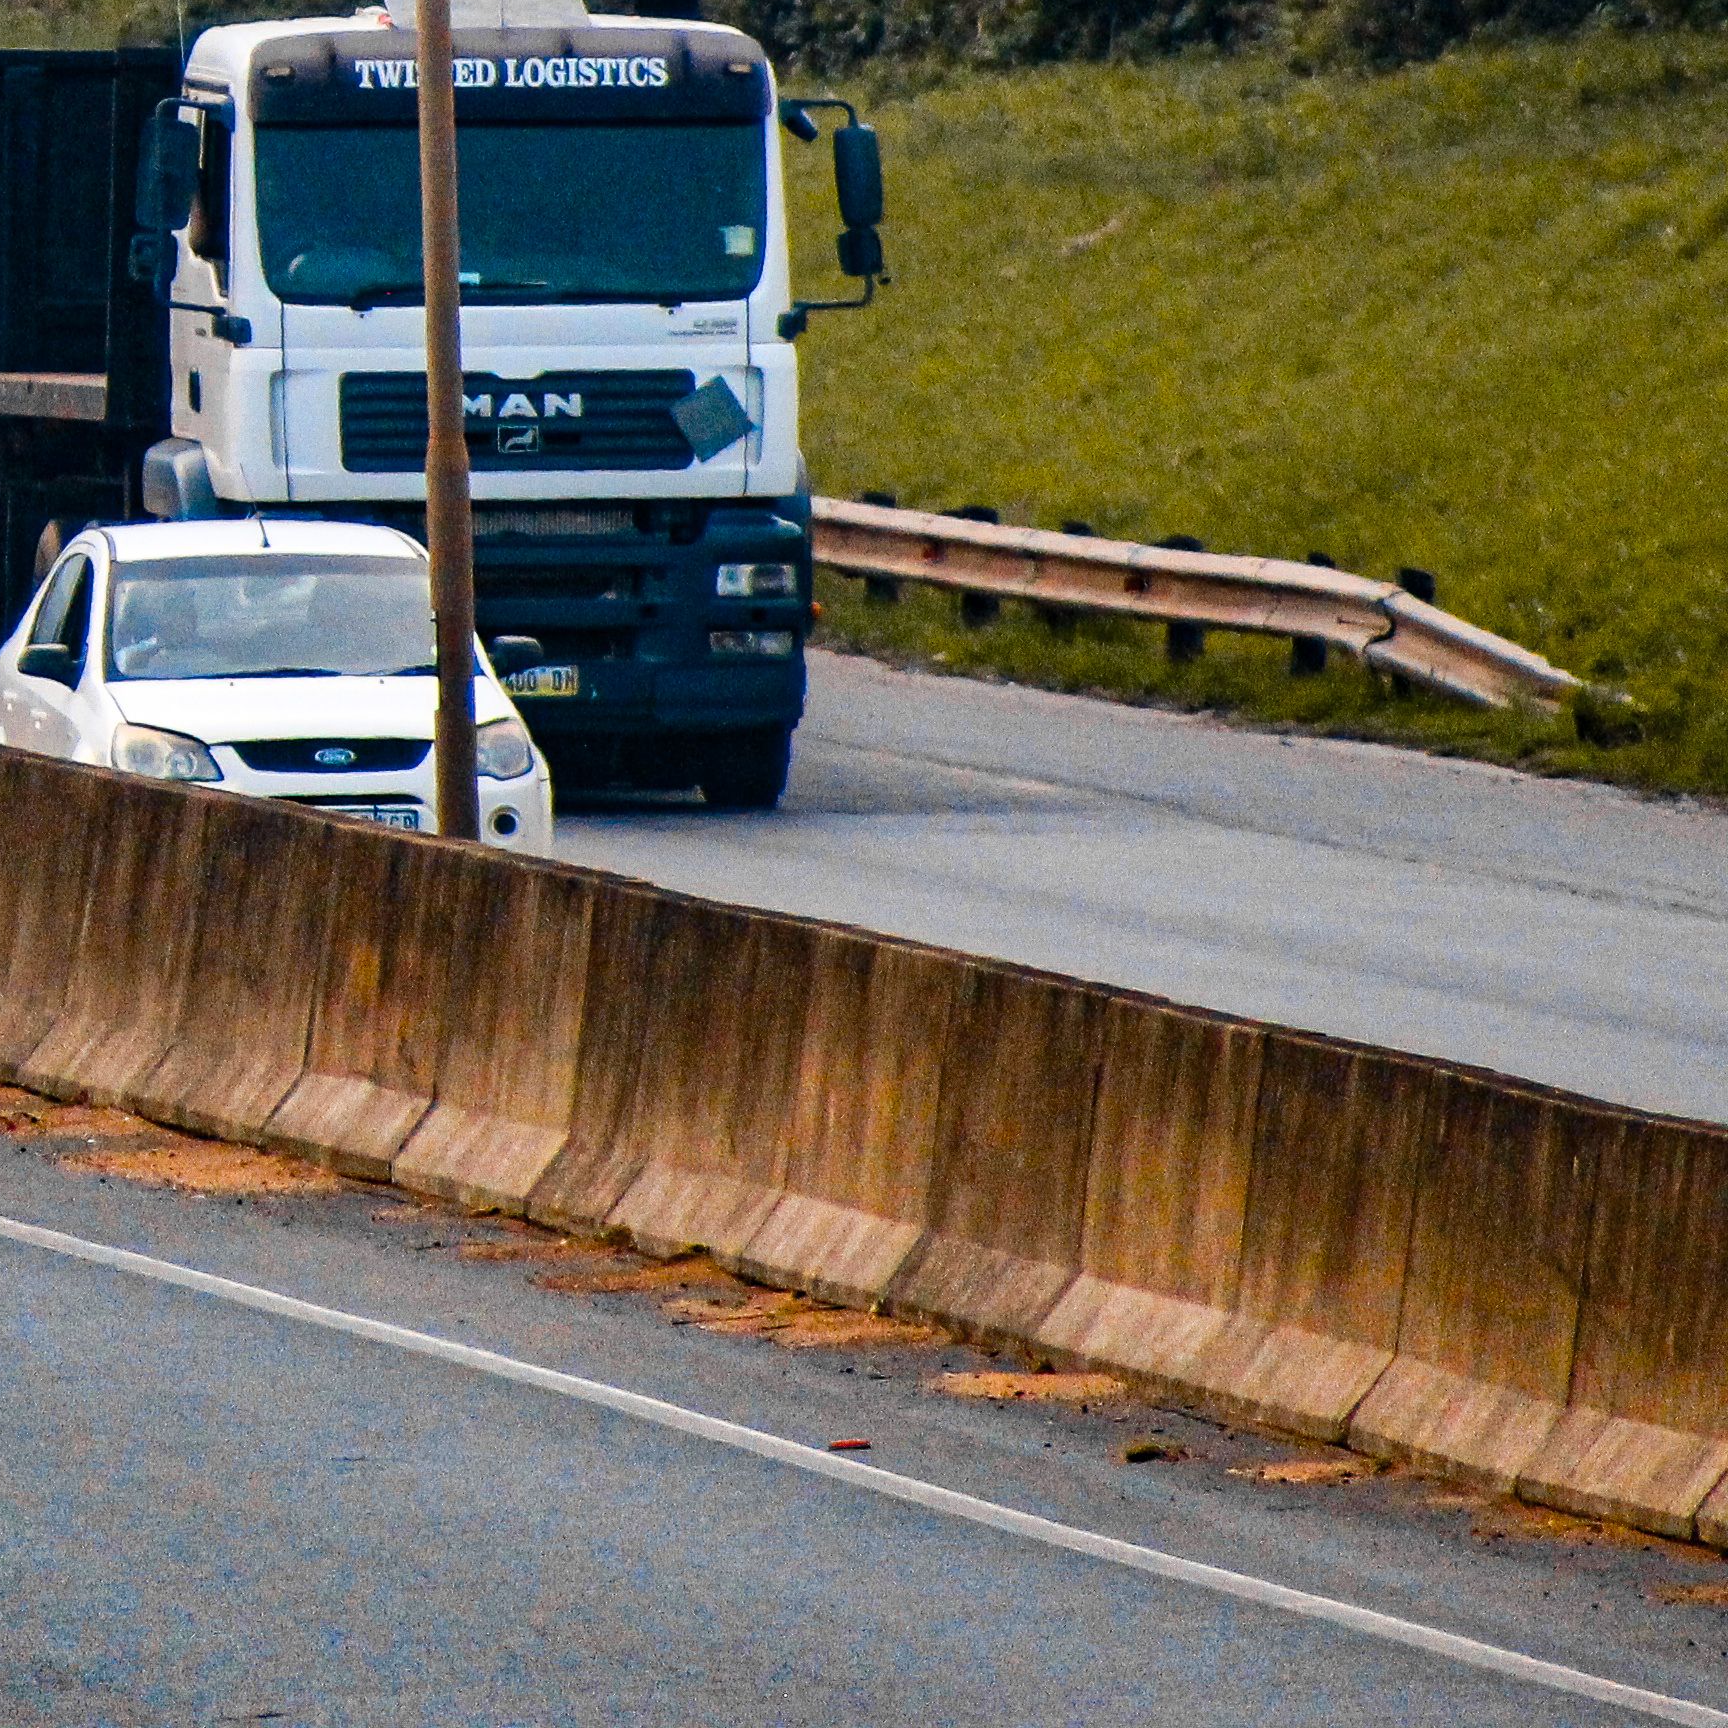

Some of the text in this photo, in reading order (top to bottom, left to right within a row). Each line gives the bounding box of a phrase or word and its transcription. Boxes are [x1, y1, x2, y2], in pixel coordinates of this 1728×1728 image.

[355, 57, 669, 89] TWIED LOGISTICS
[462, 393, 582, 418] MAN
